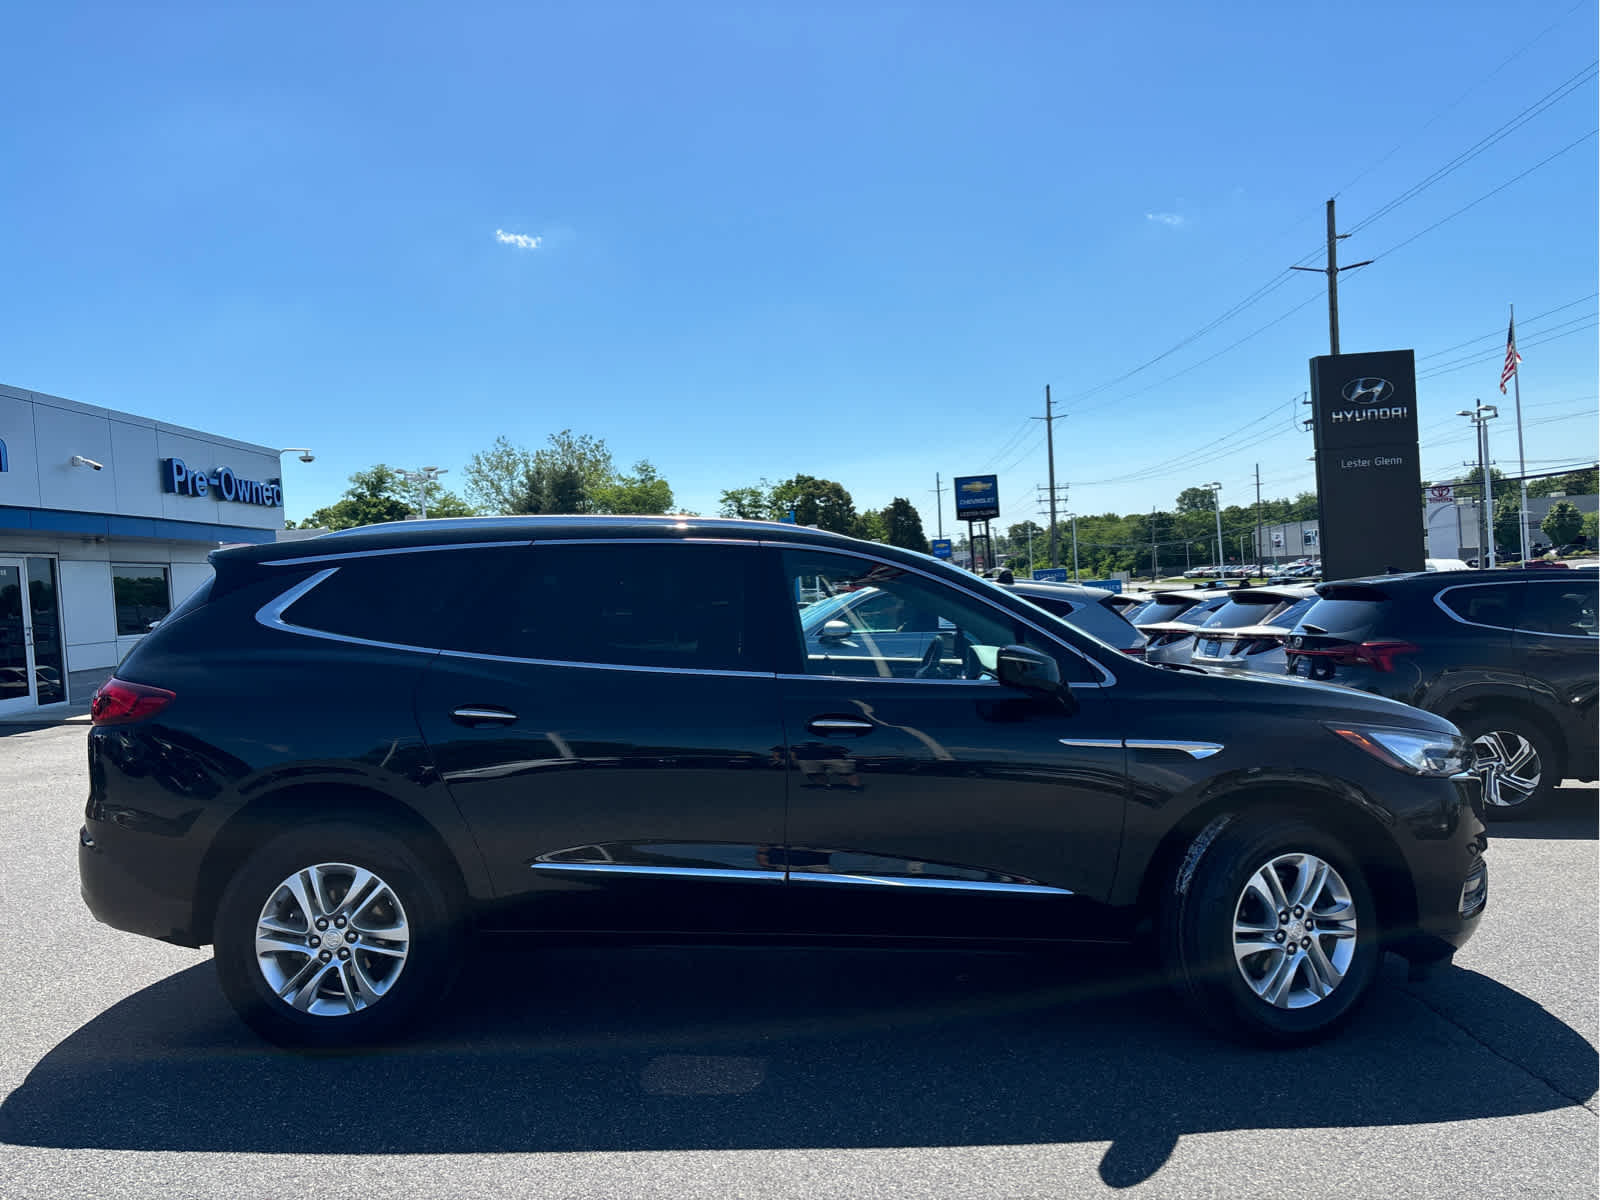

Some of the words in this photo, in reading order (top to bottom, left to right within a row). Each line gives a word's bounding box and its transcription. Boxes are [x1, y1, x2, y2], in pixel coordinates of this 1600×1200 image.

[1333, 406, 1407, 423] HYUNDAI
[1341, 458, 1370, 468] Lester
[1374, 456, 1402, 466] Glenn
[166, 457, 282, 507] Pre-Owned
